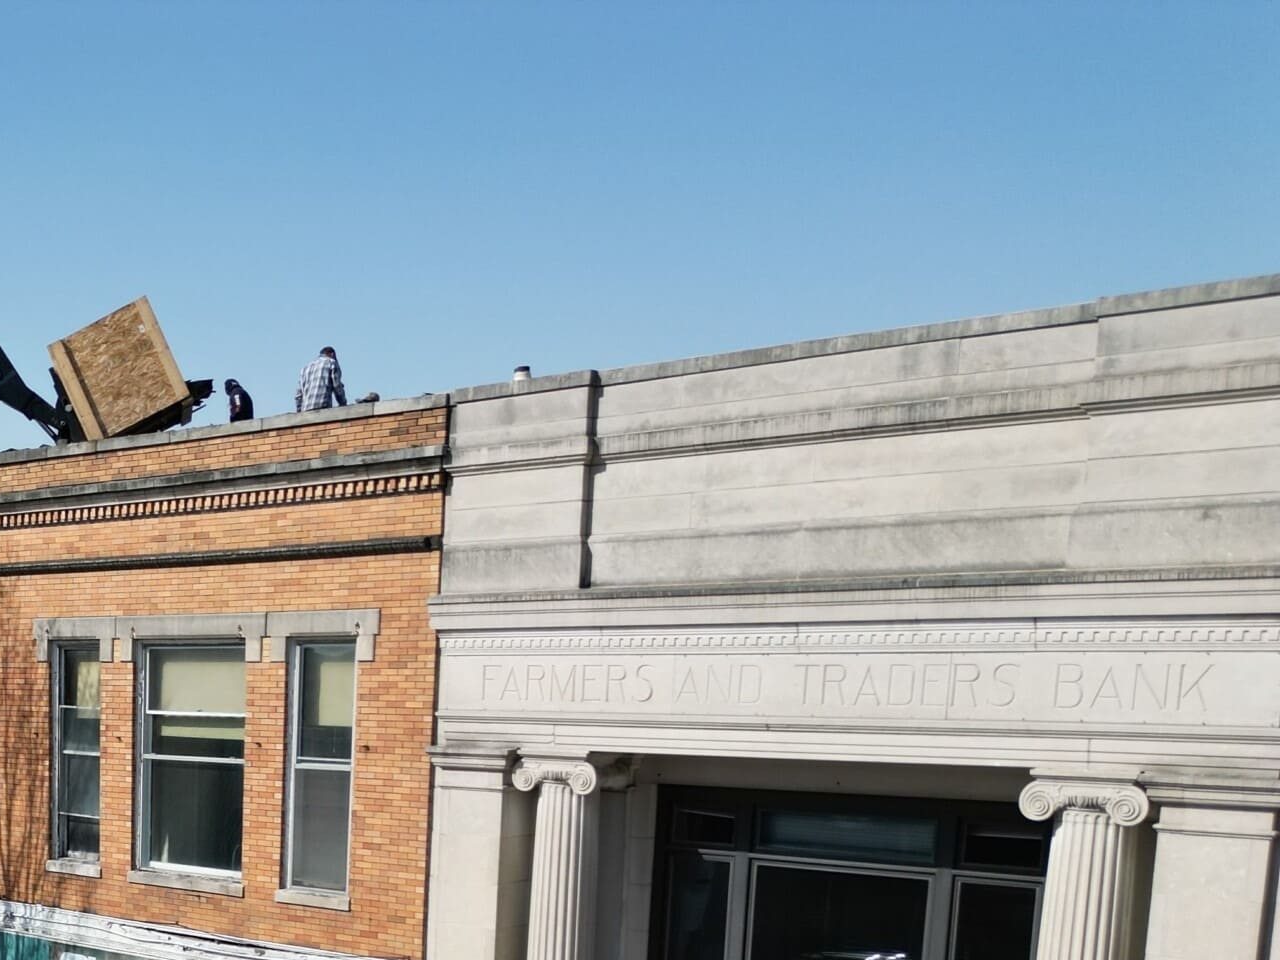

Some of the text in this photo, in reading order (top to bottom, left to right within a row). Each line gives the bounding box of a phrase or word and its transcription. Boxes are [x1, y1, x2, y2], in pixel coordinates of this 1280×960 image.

[480, 663, 1215, 712] FARMERS AND TRADERS BANK
